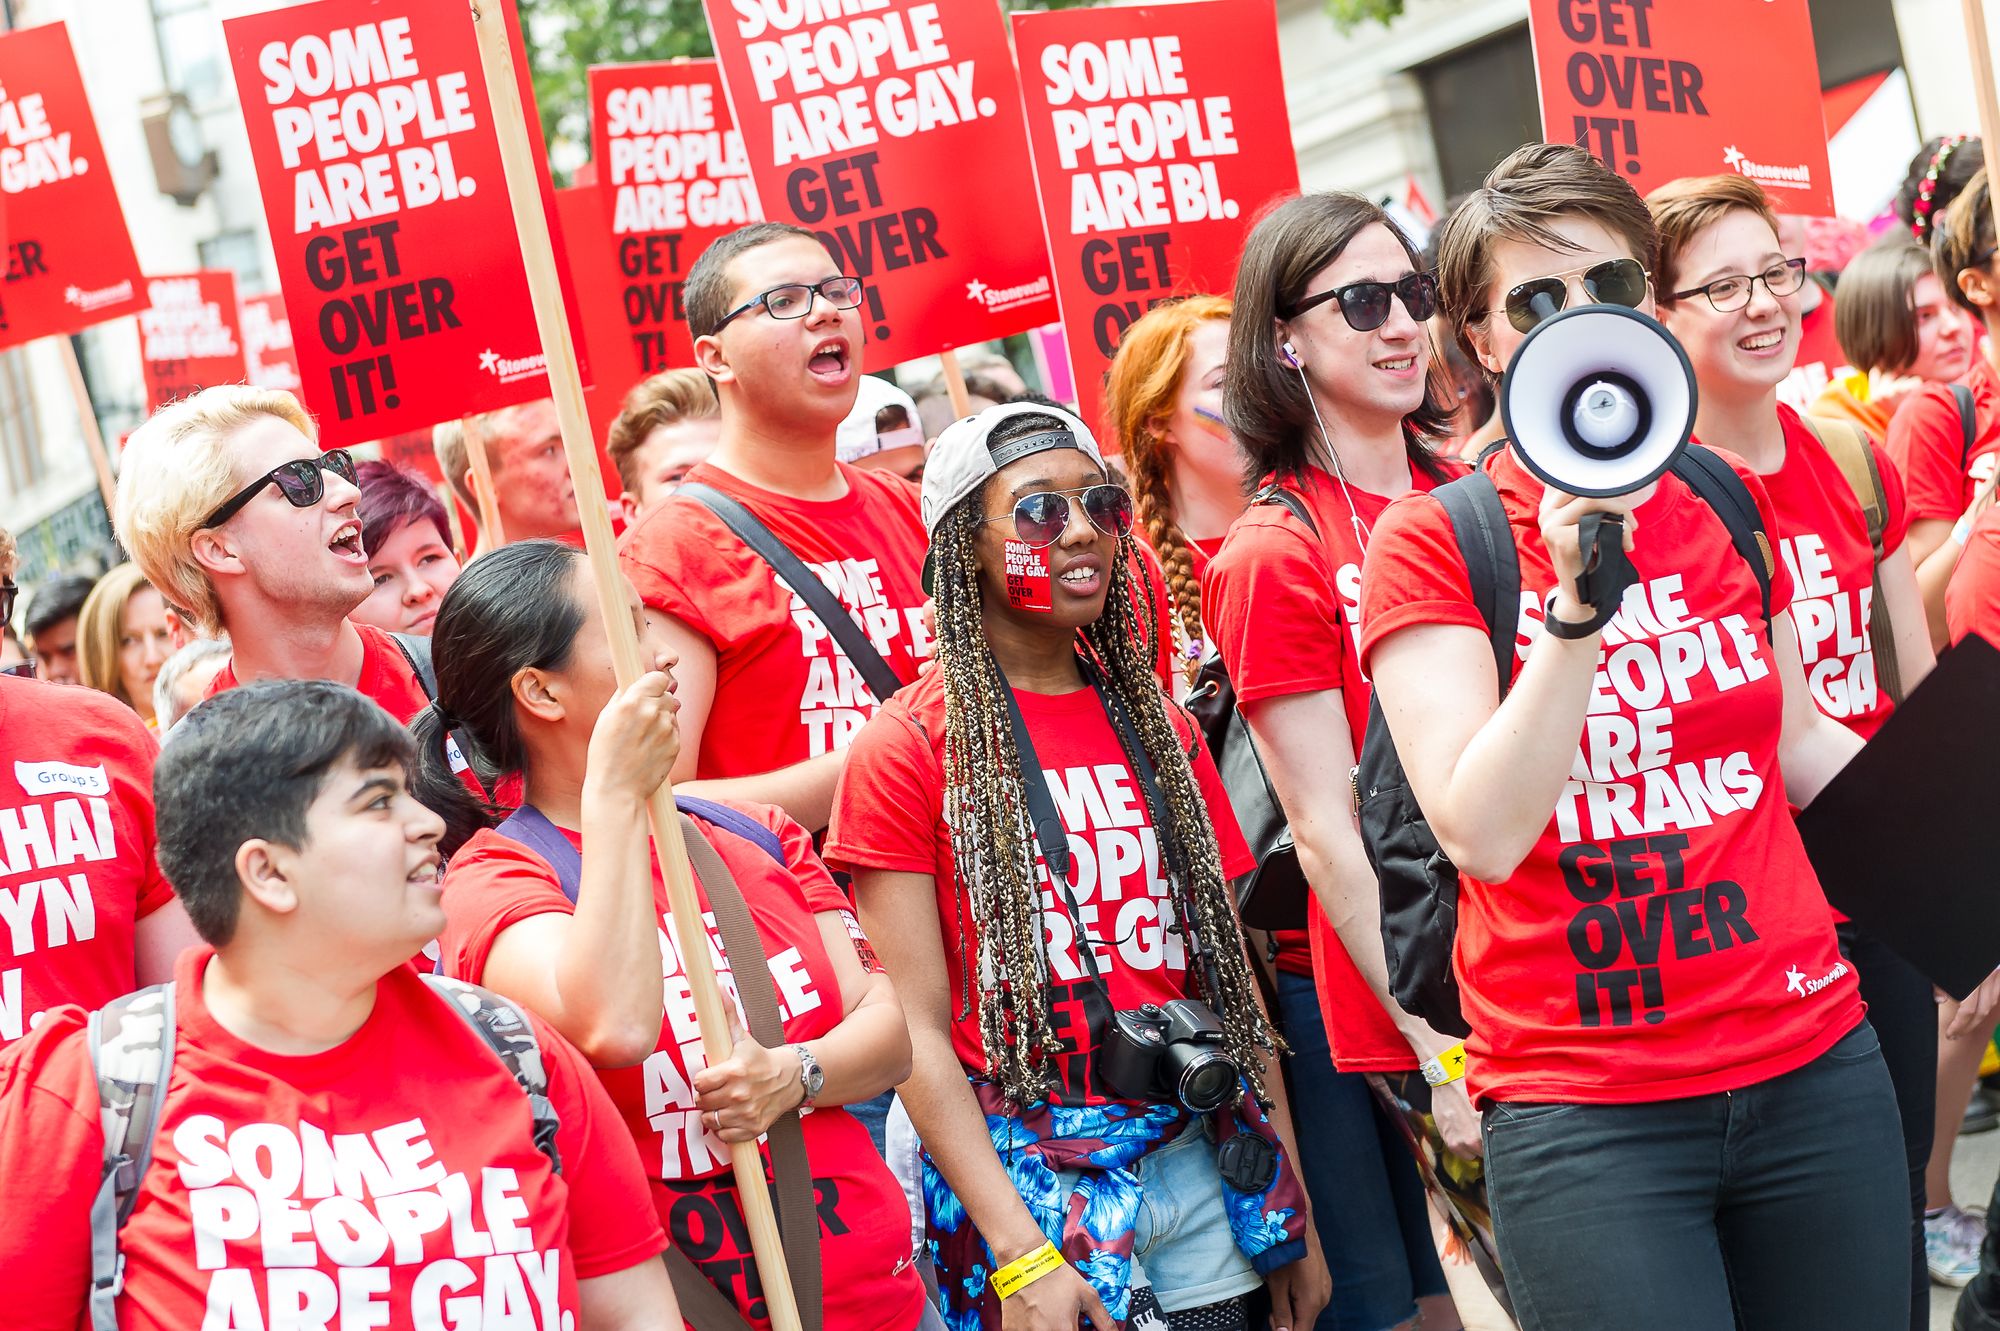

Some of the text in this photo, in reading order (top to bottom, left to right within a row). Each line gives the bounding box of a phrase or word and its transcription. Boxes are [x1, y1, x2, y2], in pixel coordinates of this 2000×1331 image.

[732, 0, 890, 39] SO
[745, 2, 950, 102] PEOPLE
[1557, 0, 1654, 48] GET
[259, 17, 419, 105] SOME
[1040, 36, 1189, 105] SOME
[1566, 51, 1710, 116] OVER
[272, 71, 477, 170] PEOPLE
[606, 83, 715, 137] SOME
[771, 60, 997, 167] ARE GAY.
[1051, 96, 1239, 169] PEOPLE
[609, 130, 750, 186] PEOPLE
[1573, 115, 1642, 175] IT!
[295, 141, 477, 234] ARE BI.
[613, 182, 688, 234] ARE
[786, 151, 885, 223] GET
[1070, 160, 1240, 235] ARE BI.
[304, 219, 403, 292] GET
[619, 233, 682, 278] GET
[1081, 232, 1173, 296] GET
[318, 276, 463, 355] OVER
[623, 281, 687, 326] OVE
[632, 331, 667, 373] T!
[329, 353, 401, 421] IT!
[1004, 541, 1032, 555] SOME
[1005, 553, 1041, 566] PEOPLE
[1006, 565, 1049, 577] ARE GAY.
[1007, 575, 1025, 587] GET
[1008, 586, 1033, 598] OVER
[1515, 573, 1704, 662] SME
[800, 656, 882, 710] AR
[1586, 613, 1770, 716] EOPLE
[1808, 650, 1878, 719] GA
[38, 769, 100, 788] Group 5
[1042, 764, 1145, 833] ME
[1556, 751, 1764, 844] TRANS
[0, 798, 117, 877] HAI
[1558, 833, 1691, 904] GET
[1115, 897, 1187, 971] GA
[1567, 880, 1760, 971] OVER
[1575, 964, 1668, 1028] IT!
[173, 1114, 448, 1201] SOME
[189, 1167, 535, 1270] PEOPLE
[201, 1249, 576, 1331] ARE GAY.
